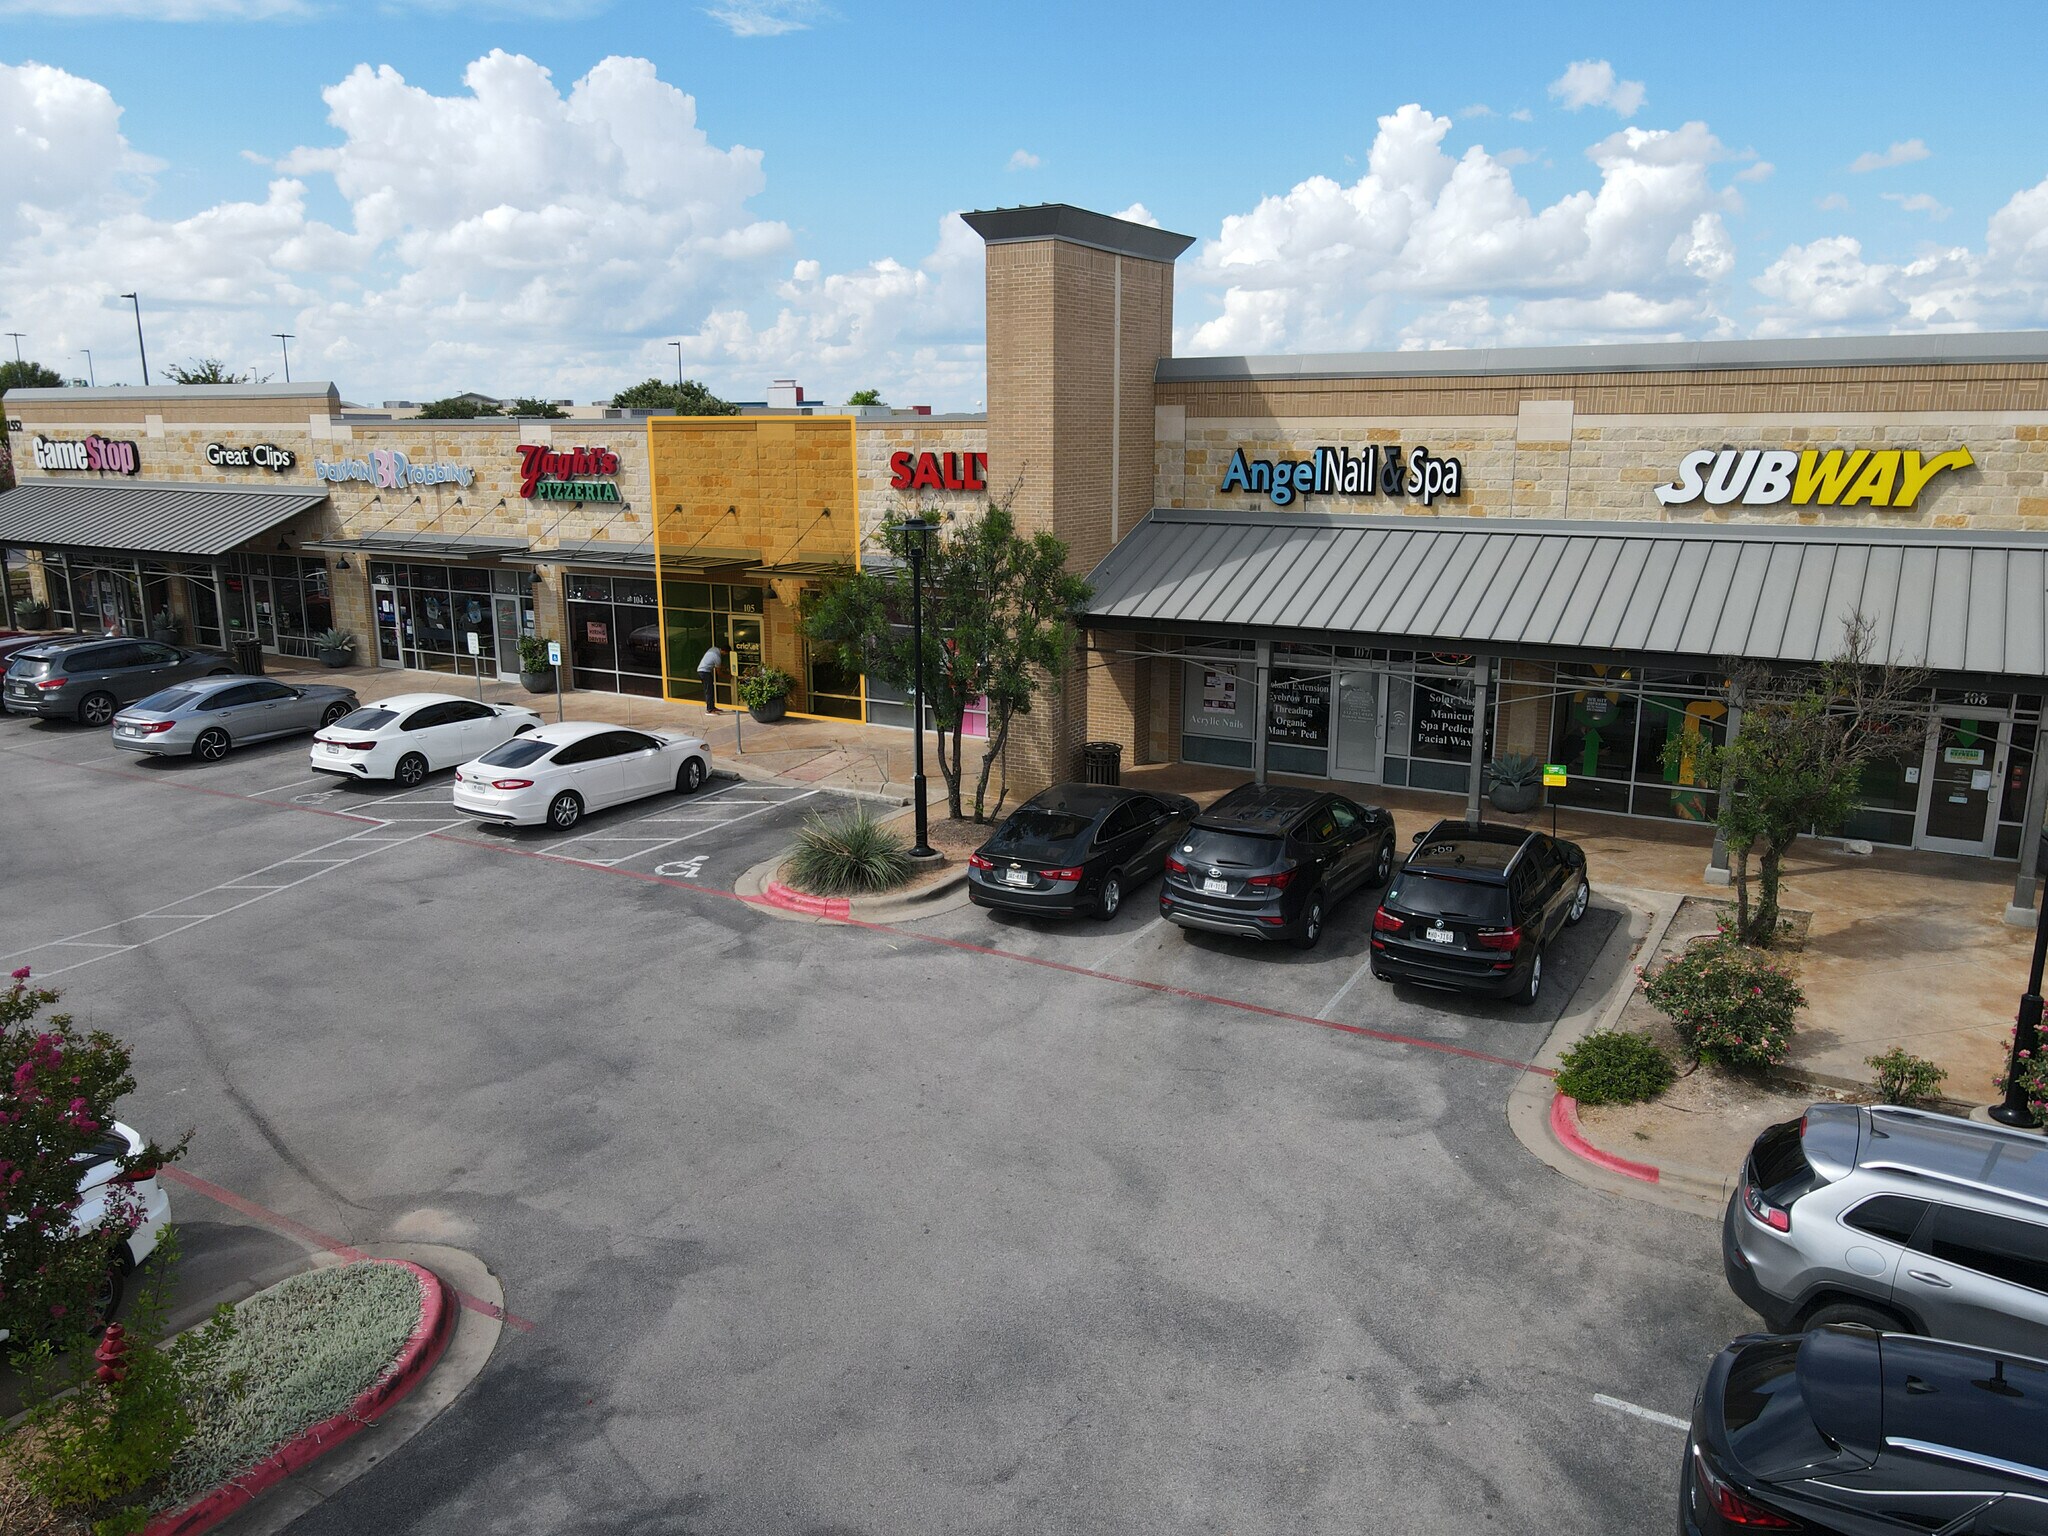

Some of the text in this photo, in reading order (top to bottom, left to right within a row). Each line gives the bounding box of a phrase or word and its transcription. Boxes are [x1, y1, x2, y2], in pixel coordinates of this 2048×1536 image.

[32, 435, 137, 474] GameStop
[206, 444, 291, 471] Great Clips
[516, 445, 618, 498] Yaghi's
[1380, 446, 1405, 496] &
[1407, 448, 1458, 505] Spa
[1654, 445, 1974, 507] SUBWAY
[537, 482, 615, 501] PIZZERIA
[743, 603, 755, 613] 105
[1304, 694, 1320, 705] Tint
[1963, 692, 1988, 706] 108
[1273, 704, 1313, 717] Threading
[1431, 709, 1475, 721] Manicur
[1191, 714, 1244, 729] Acrylic Nails
[1276, 716, 1307, 728] Organic
[1420, 719, 1439, 732] Spa
[1268, 726, 1288, 736] Mani
[1301, 729, 1318, 739] Pedi
[1418, 733, 1447, 745] Facial
